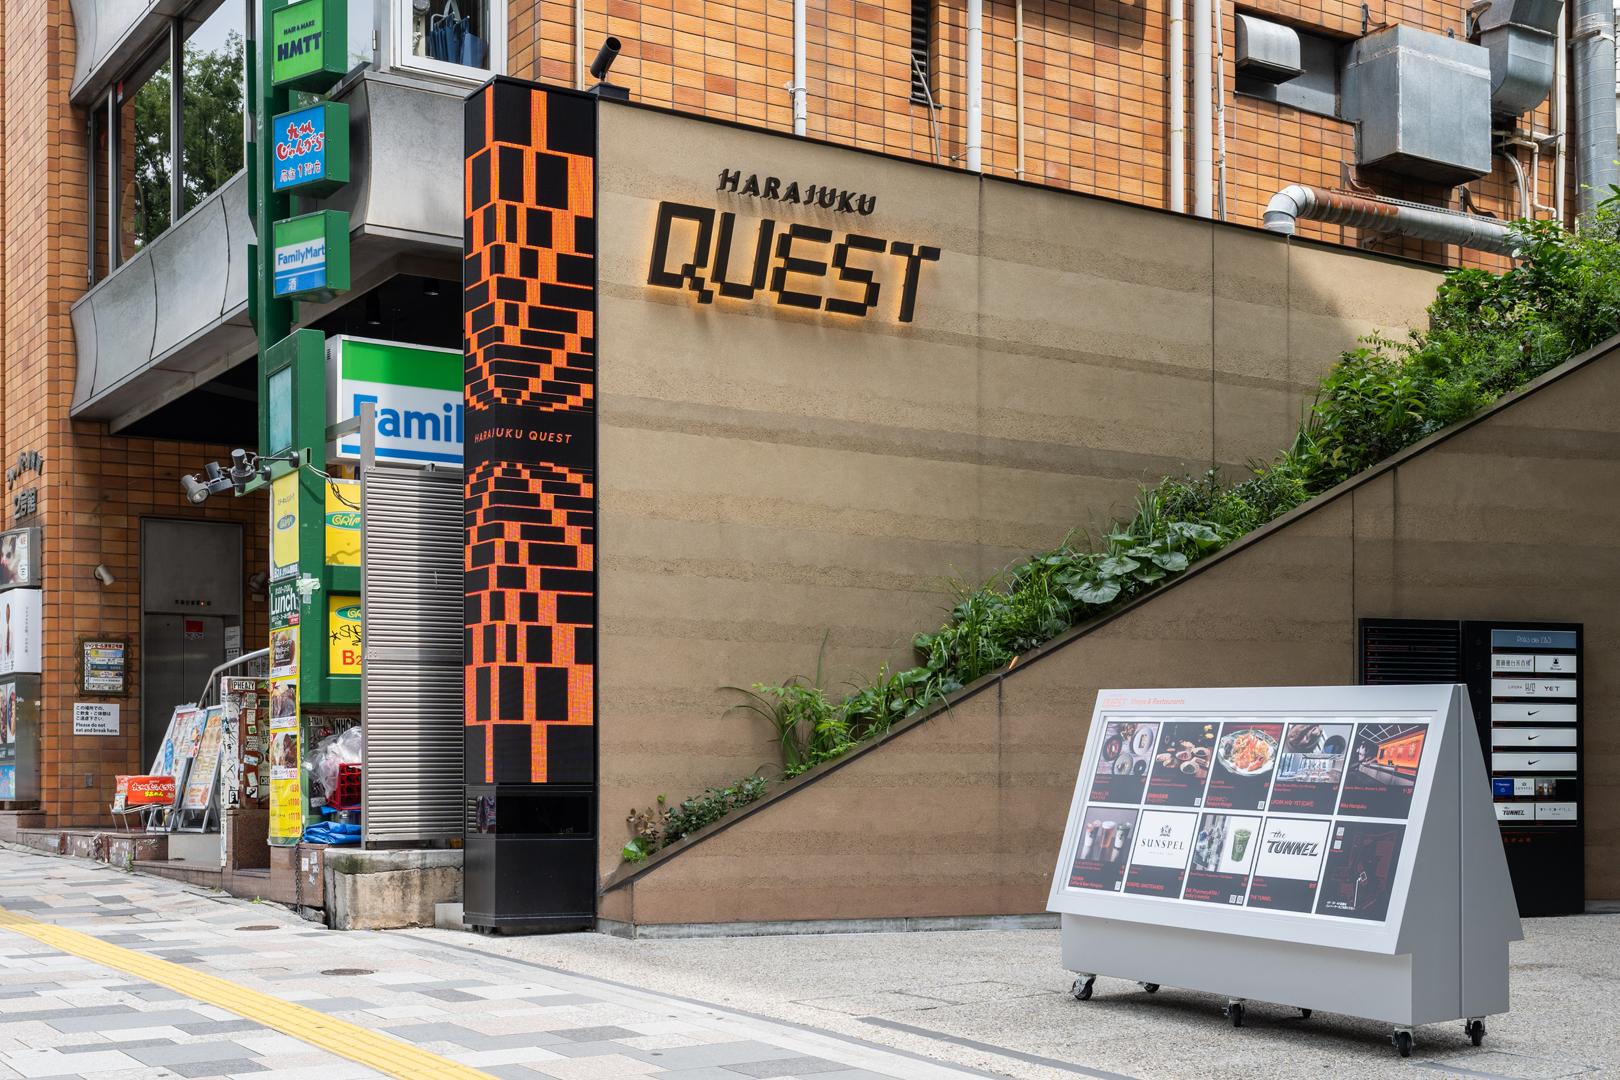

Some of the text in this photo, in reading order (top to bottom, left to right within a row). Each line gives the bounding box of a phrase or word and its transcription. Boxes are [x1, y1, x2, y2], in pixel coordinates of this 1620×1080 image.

[284, 26, 296, 36] HAIR
[301, 20, 315, 30] MAKE
[277, 31, 322, 62] HMTT
[716, 168, 877, 216] HARAJUKU
[278, 244, 325, 266] FamilyMart
[647, 201, 941, 322] QUEST
[528, 430, 572, 444] QUEST
[271, 587, 297, 616] Lunch
[1102, 698, 1128, 708] QUEST
[1140, 838, 1184, 850] SUNSPEL
[1267, 840, 1320, 857] TUNNEL
